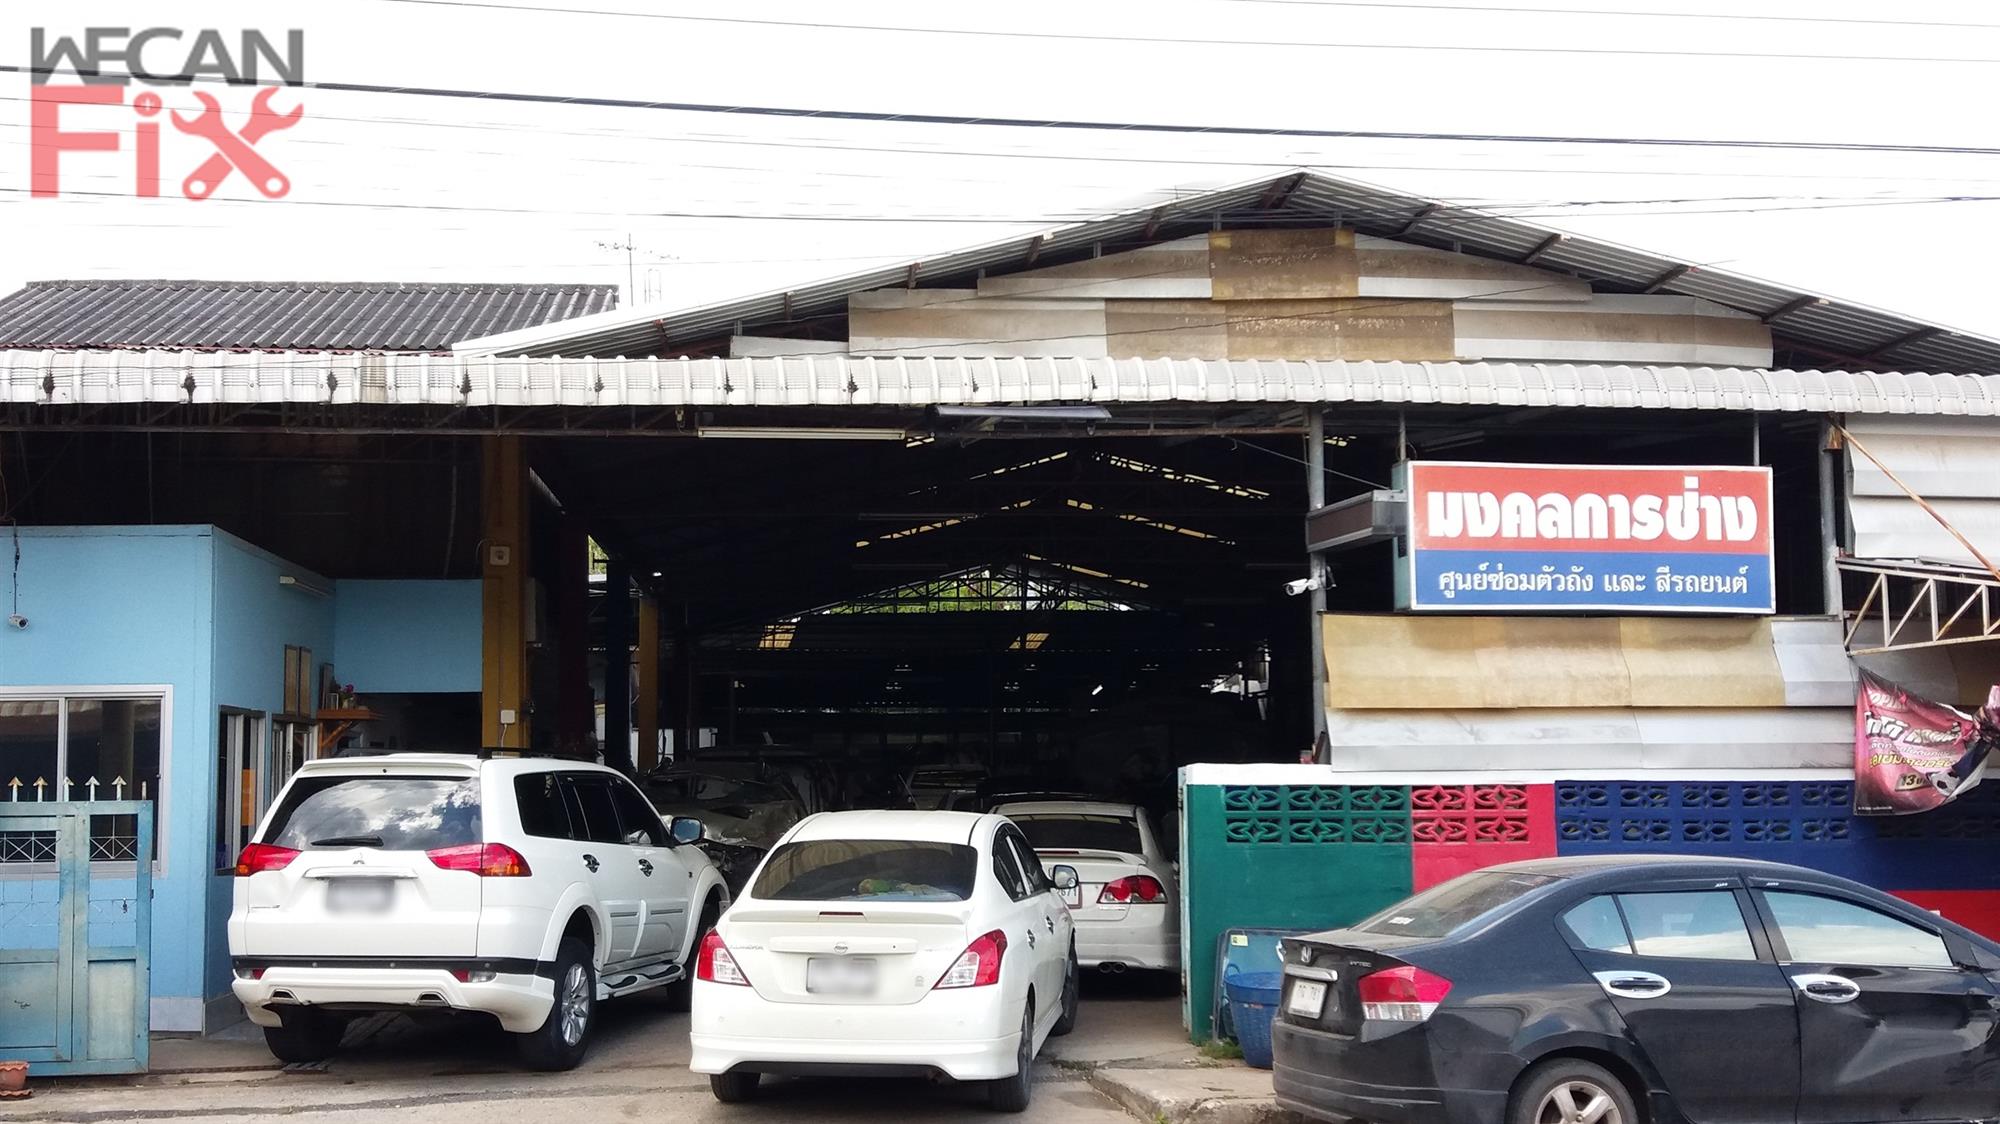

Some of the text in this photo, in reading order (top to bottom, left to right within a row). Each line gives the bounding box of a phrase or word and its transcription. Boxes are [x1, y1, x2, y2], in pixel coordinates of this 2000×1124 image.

[1427, 475, 1758, 542] มงคลการช่าง
[1438, 561, 1750, 599] ศูนย์ซ่อมตัวถัง และ สีรถยนต์
